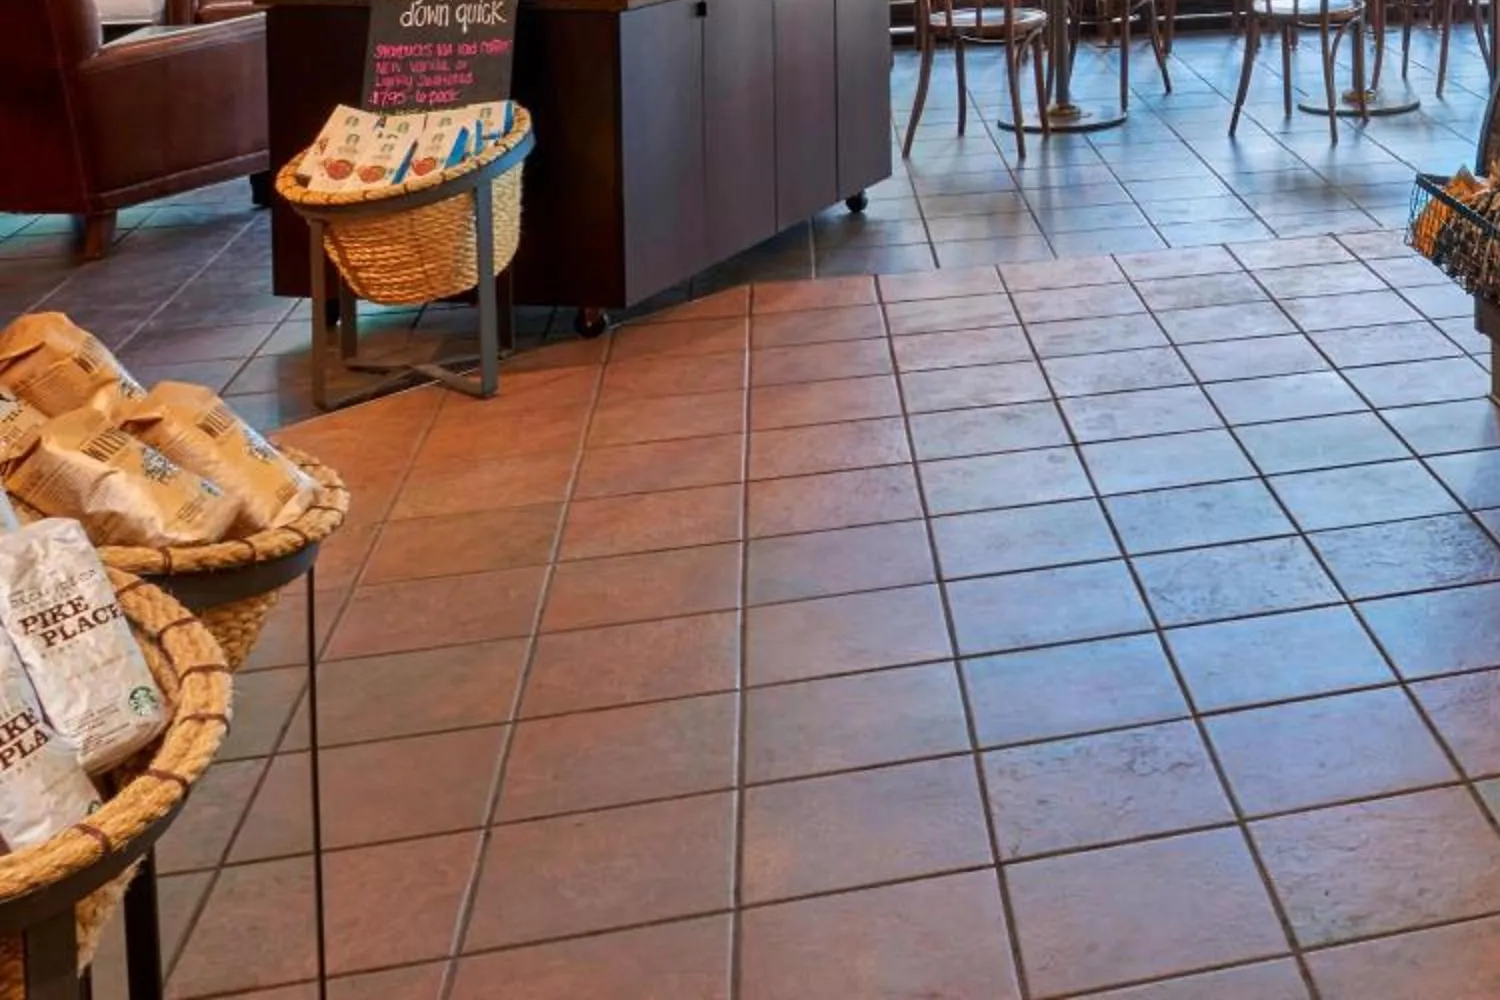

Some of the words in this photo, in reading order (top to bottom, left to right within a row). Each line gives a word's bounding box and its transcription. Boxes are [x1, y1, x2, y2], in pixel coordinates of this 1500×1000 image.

[400, 3, 450, 28] down
[455, 0, 508, 33] quick
[18, 594, 90, 636] PIKE
[38, 602, 125, 649] PLACE
